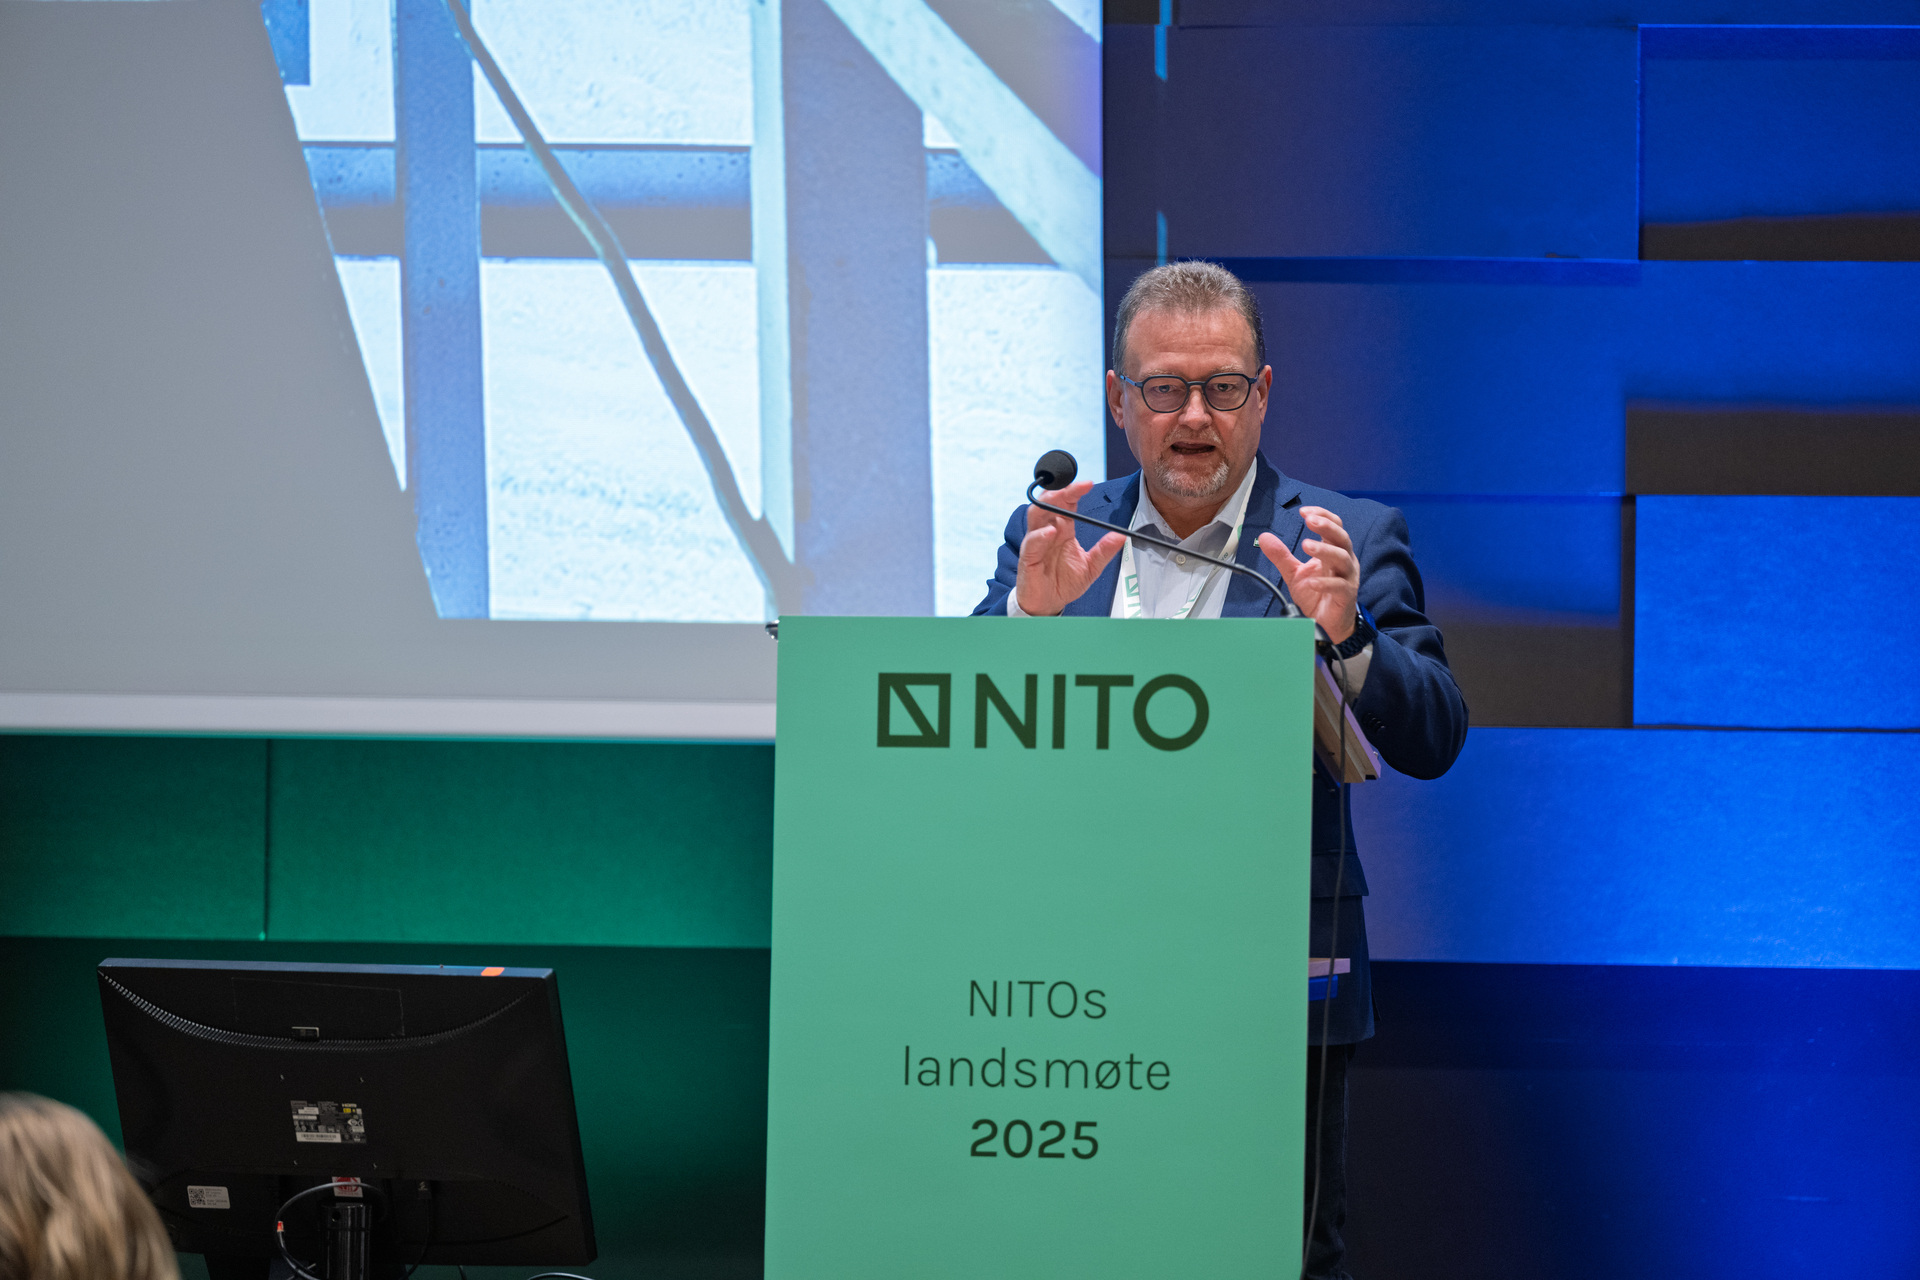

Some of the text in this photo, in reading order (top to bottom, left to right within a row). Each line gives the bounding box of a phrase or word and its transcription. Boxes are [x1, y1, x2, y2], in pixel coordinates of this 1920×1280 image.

[975, 674, 1210, 752] NITO
[969, 979, 1107, 1020] NITOs
[904, 1045, 1171, 1091] landsmøte
[970, 1118, 1099, 1160] 2025
